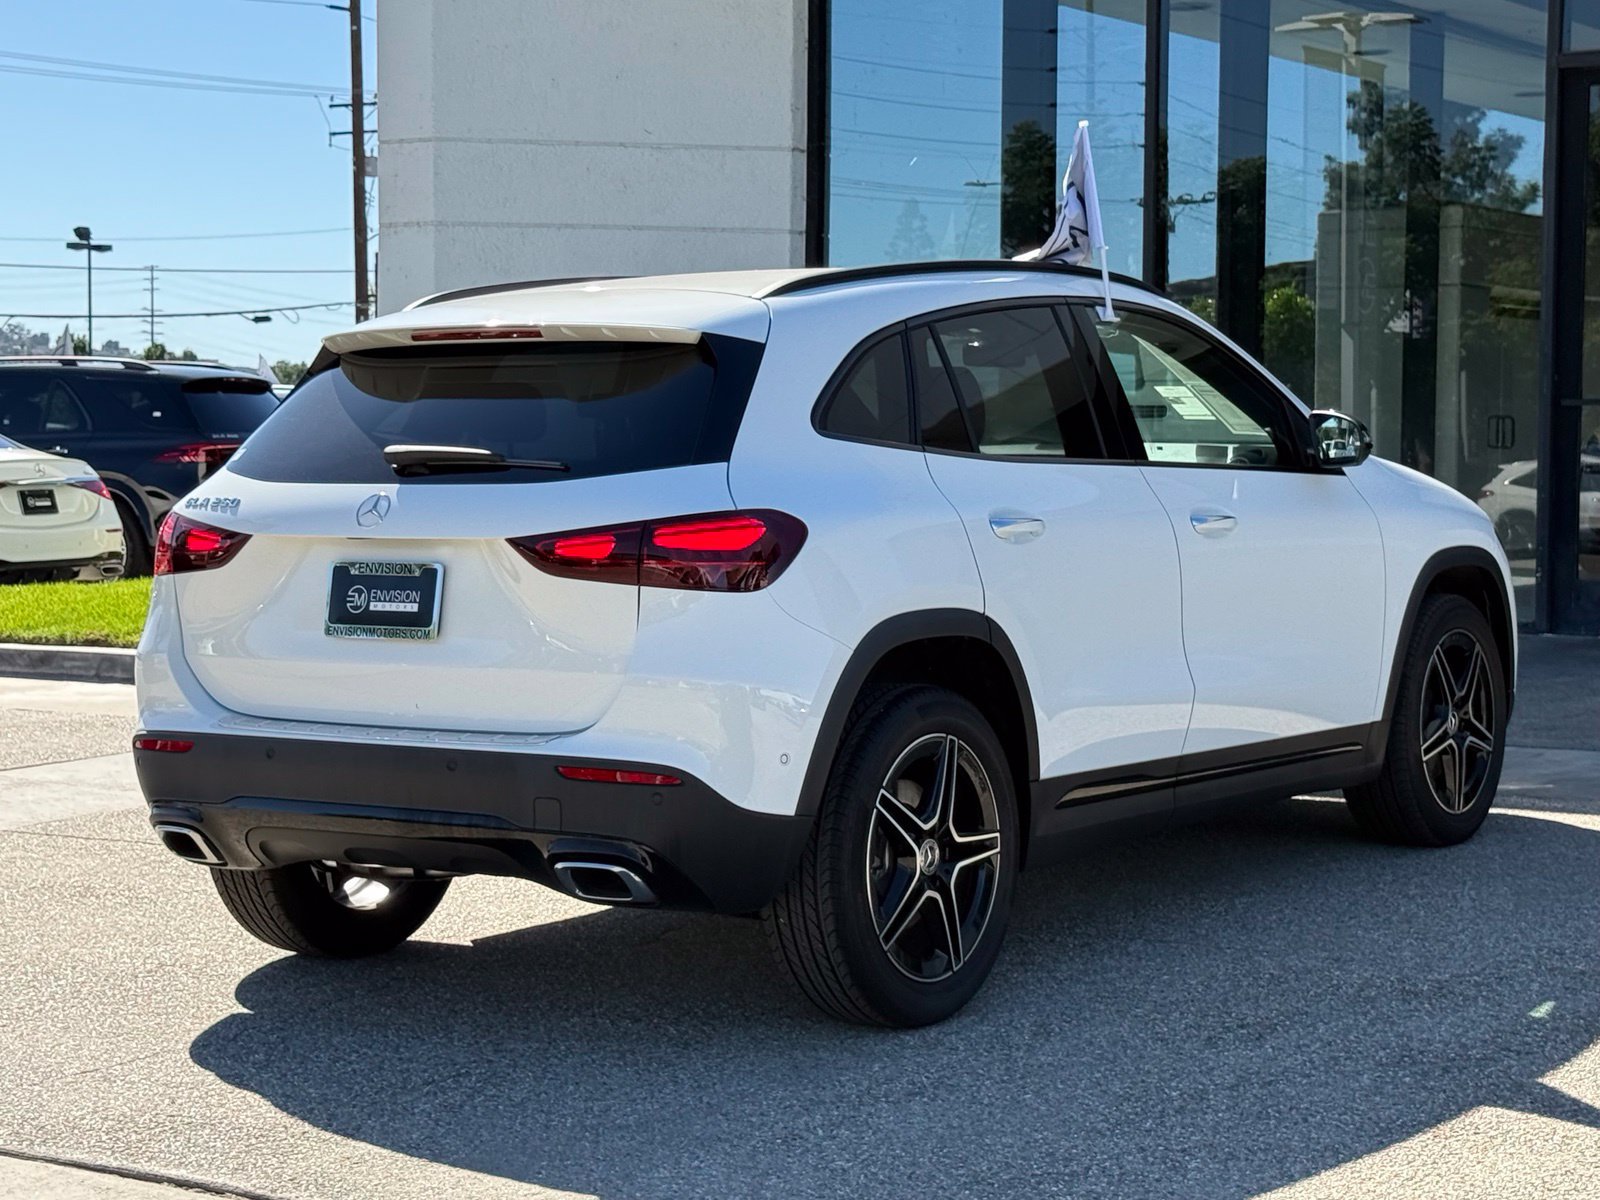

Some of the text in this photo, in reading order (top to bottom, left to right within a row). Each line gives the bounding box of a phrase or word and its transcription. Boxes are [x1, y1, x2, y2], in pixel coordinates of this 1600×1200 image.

[358, 562, 412, 575] ENVISION
[370, 589, 420, 603] ENVISION
[373, 603, 414, 611] MOTORS
[327, 625, 431, 639] ENVISIONMOTORS.COM
